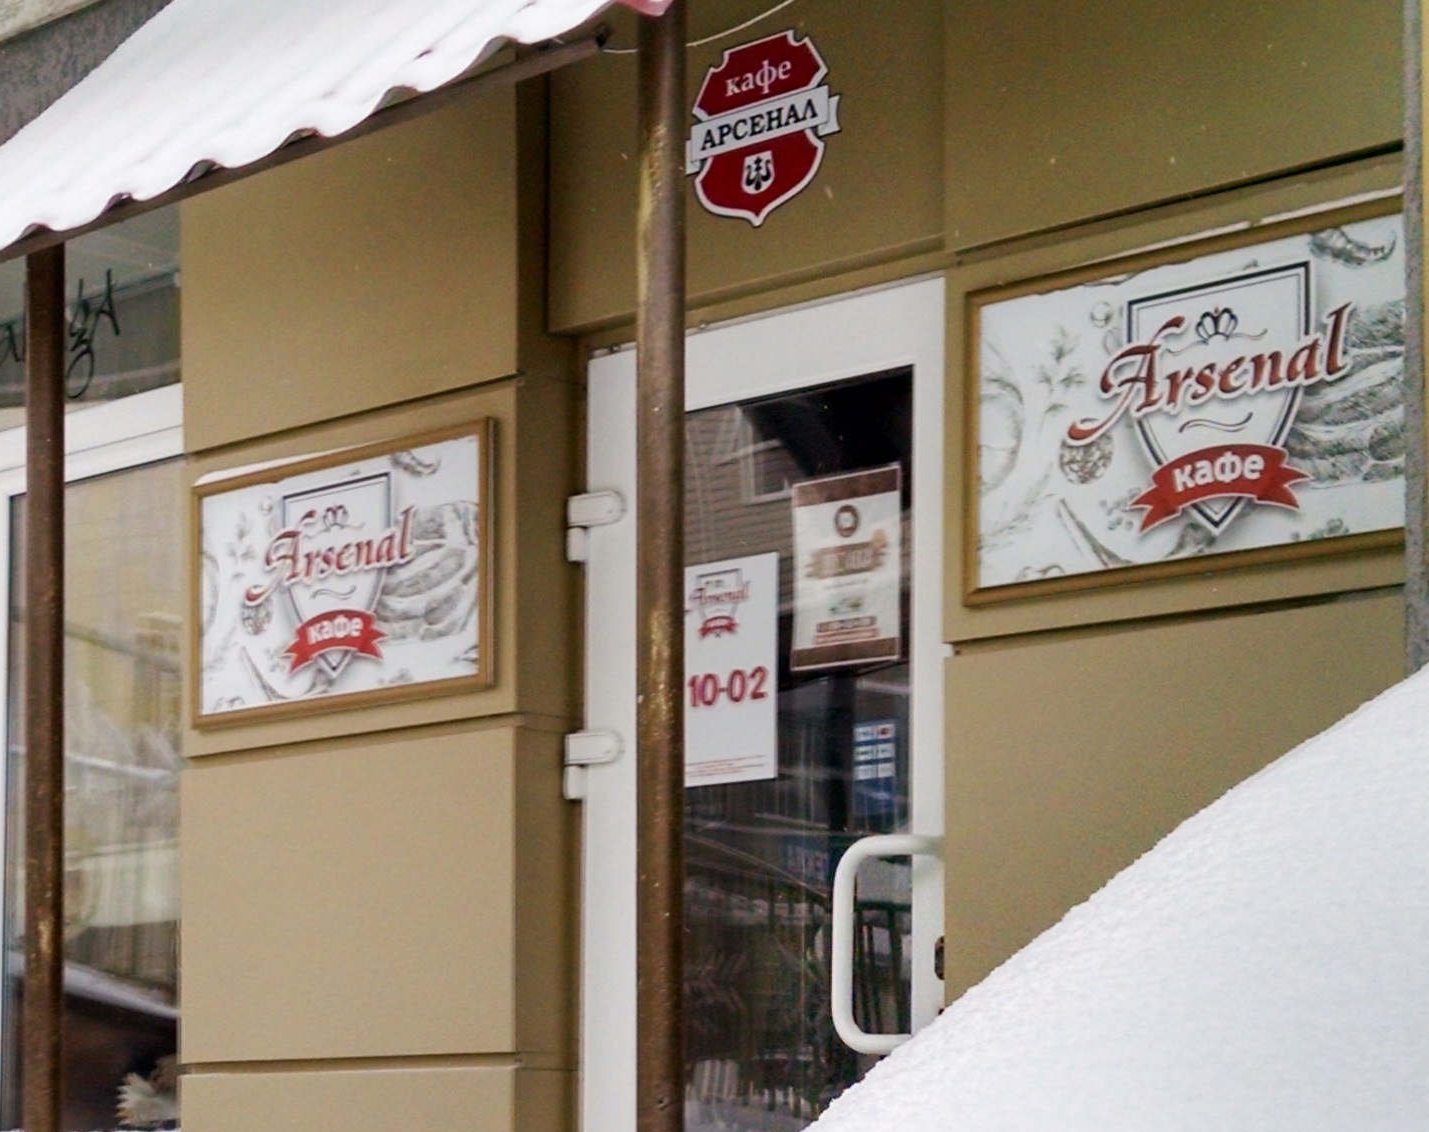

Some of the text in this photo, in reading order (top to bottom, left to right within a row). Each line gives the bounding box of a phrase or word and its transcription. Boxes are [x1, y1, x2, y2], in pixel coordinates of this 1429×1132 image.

[724, 55, 792, 97] кафе
[700, 98, 818, 151] АРСЕНАЛ
[1067, 301, 1355, 441] Arsenal
[244, 505, 416, 603] Arsenal
[688, 665, 769, 708] 10-02
